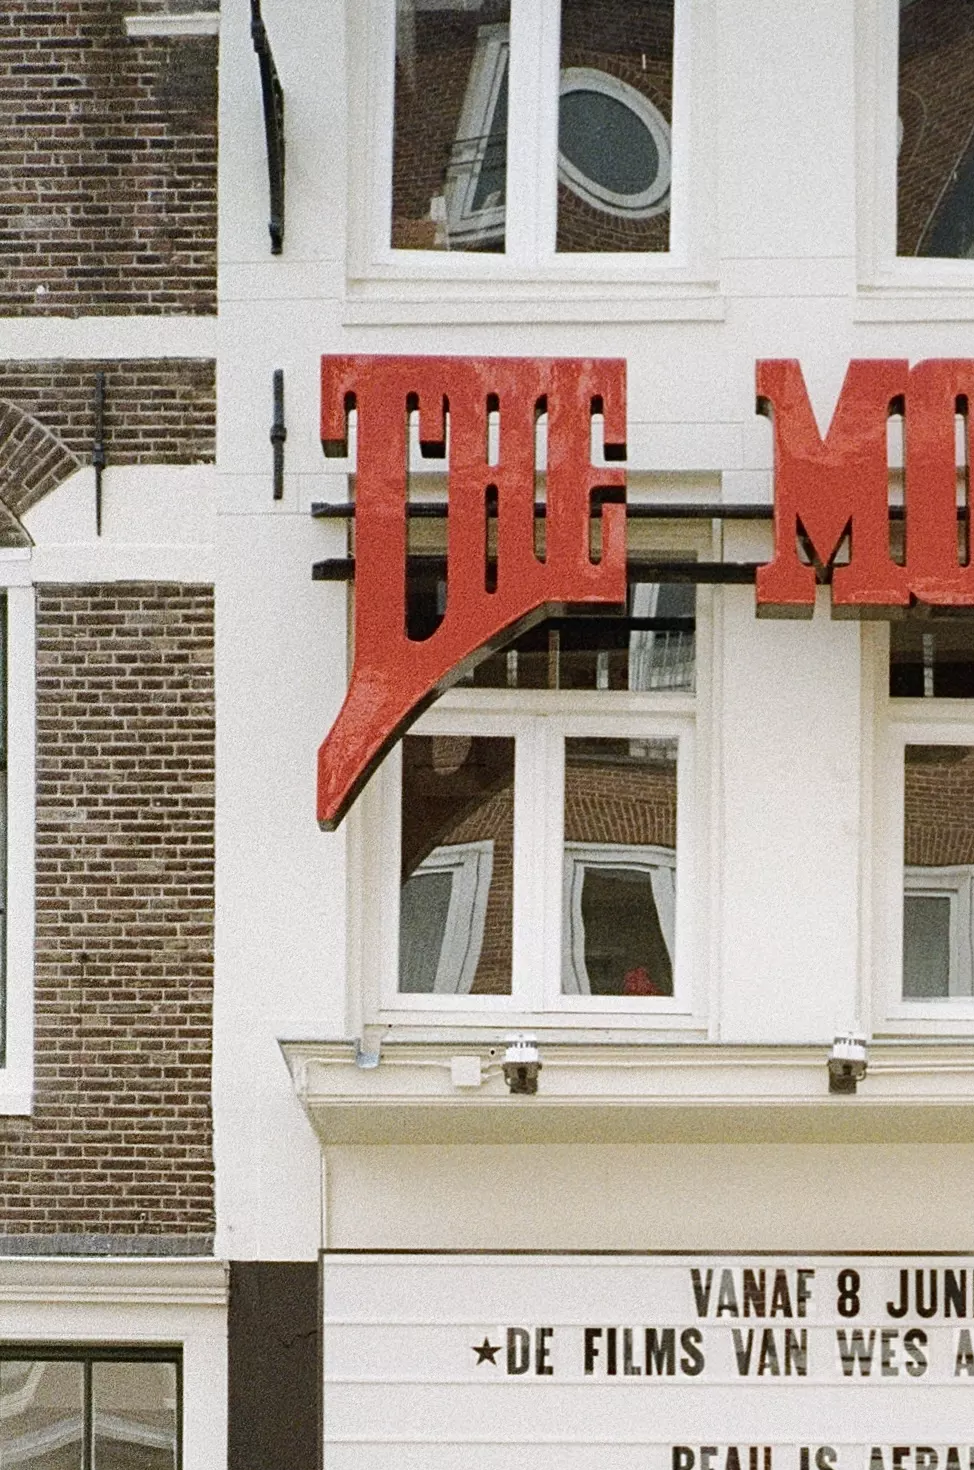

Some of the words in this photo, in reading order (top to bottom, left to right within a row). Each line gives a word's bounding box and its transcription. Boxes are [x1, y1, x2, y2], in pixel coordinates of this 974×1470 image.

[318, 355, 628, 832] THE
[690, 1267, 815, 1319] VANAF
[836, 1267, 861, 1319] 8
[505, 1327, 554, 1377] DE
[583, 1327, 705, 1377] FILMS
[733, 1327, 808, 1377] VAN
[836, 1327, 928, 1377] WES
